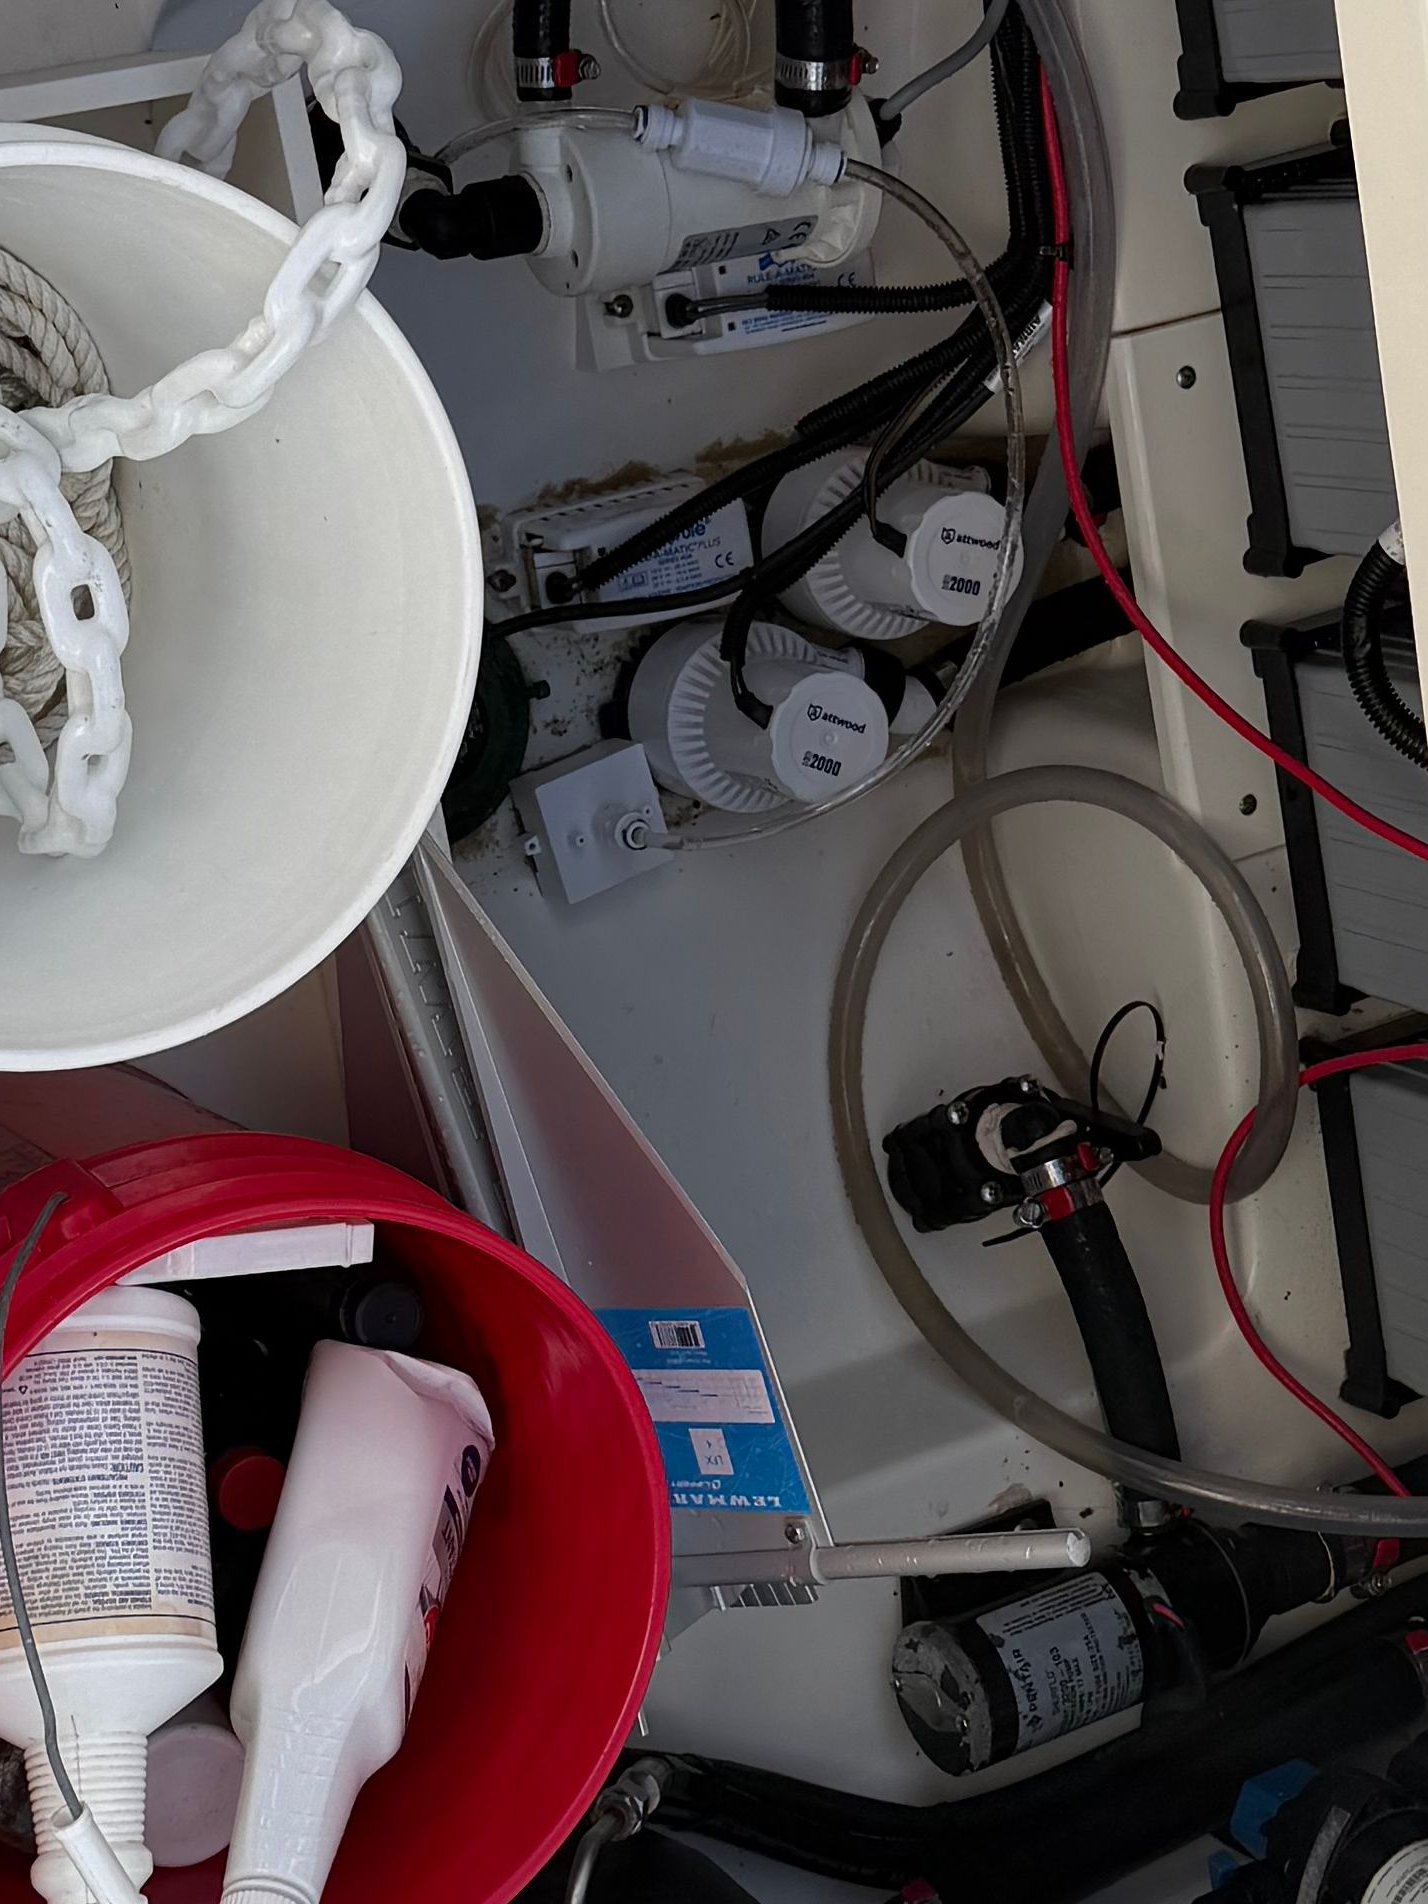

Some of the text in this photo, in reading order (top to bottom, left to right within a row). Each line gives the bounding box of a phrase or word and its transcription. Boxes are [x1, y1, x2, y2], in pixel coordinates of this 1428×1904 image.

[956, 535, 1001, 550] attwood
[949, 575, 980, 595] 2000
[822, 712, 866, 733] attwood
[809, 753, 841, 776] 2000
[672, 1493, 780, 1506] LEWMAR
[1011, 1648, 1037, 1711] PENTAIR
